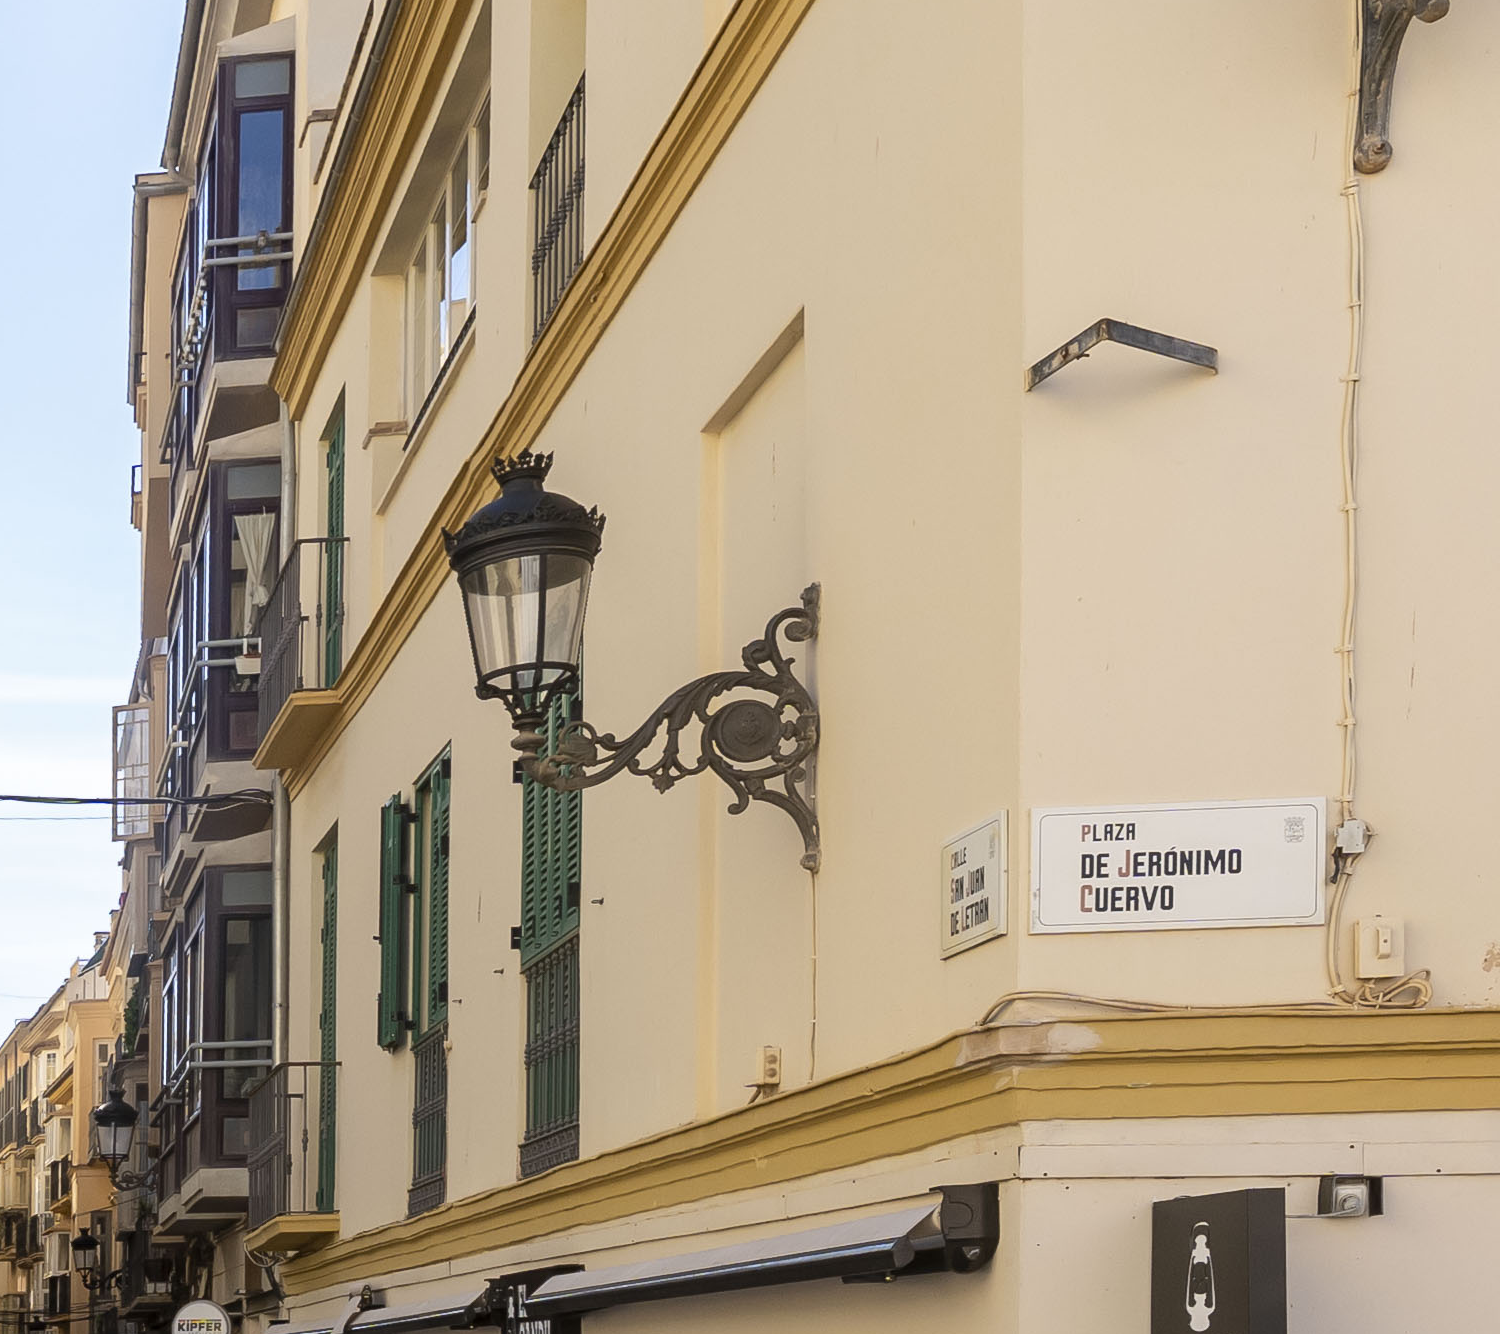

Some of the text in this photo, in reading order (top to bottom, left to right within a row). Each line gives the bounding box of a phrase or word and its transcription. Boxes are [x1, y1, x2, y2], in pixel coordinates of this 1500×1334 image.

[1081, 823, 1136, 843] PLAZA
[951, 847, 967, 870] CALLE
[1081, 846, 1243, 879] DE JERÓNIMO
[951, 866, 985, 904] SAN JUAN
[1080, 884, 1174, 913] CUERVO
[950, 910, 959, 936] DE
[177, 1319, 222, 1332] KIPFER
